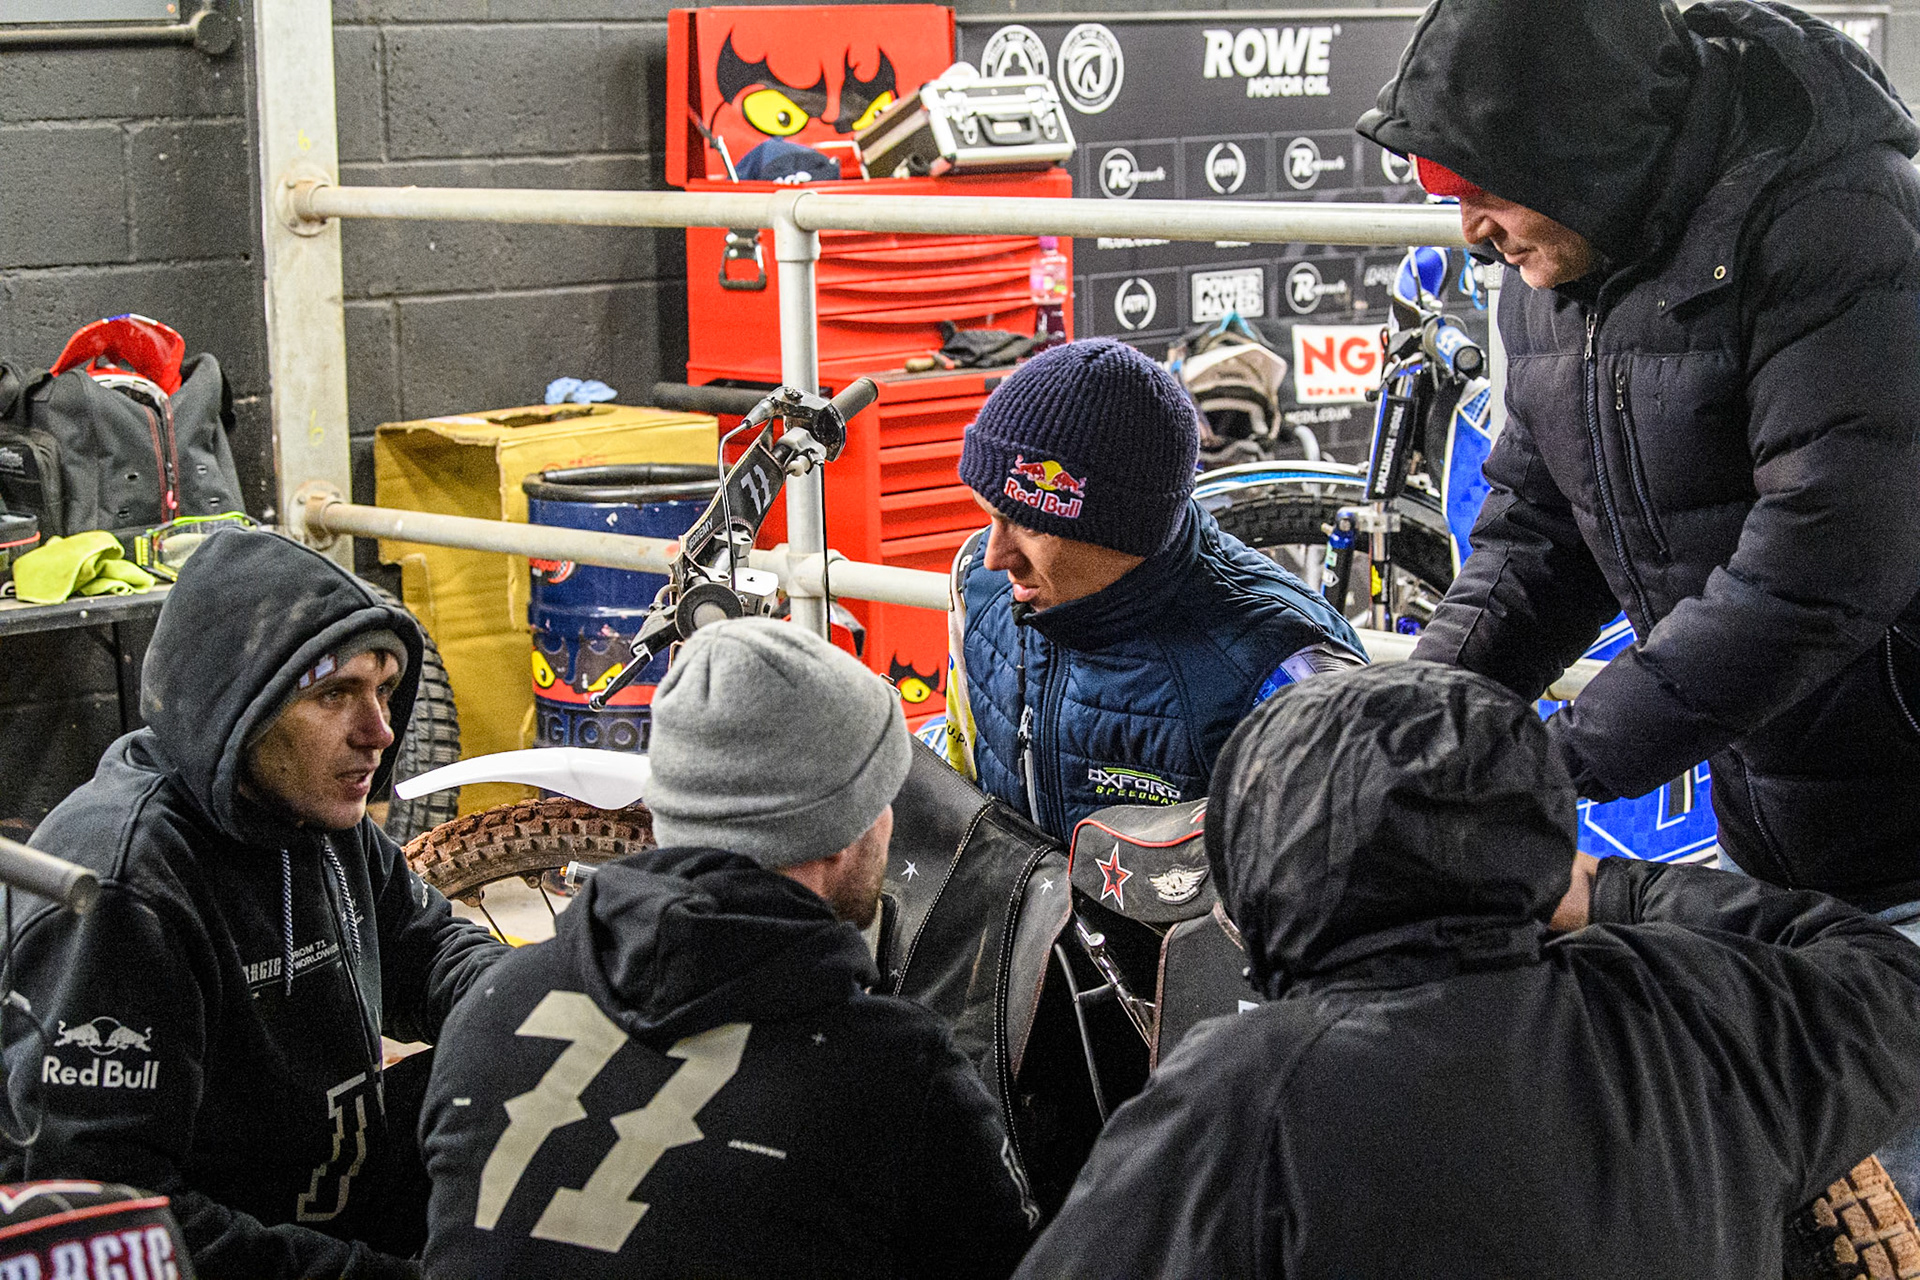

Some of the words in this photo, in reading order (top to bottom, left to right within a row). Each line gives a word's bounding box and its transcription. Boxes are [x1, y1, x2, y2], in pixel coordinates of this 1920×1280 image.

[1203, 27, 1333, 78] ROWE
[1246, 75, 1304, 98] MOTOR
[1304, 75, 1331, 96] OIL
[1302, 336, 1386, 376] NG
[1003, 477, 1043, 508] Red
[1041, 492, 1083, 518] Bull
[1088, 768, 1181, 799] OXFORD
[1095, 785, 1178, 805] SPEEDWAY
[315, 939, 327, 950] 71
[42, 1055, 100, 1086] Red
[102, 1059, 160, 1090] Bull
[474, 989, 753, 1253] 71
